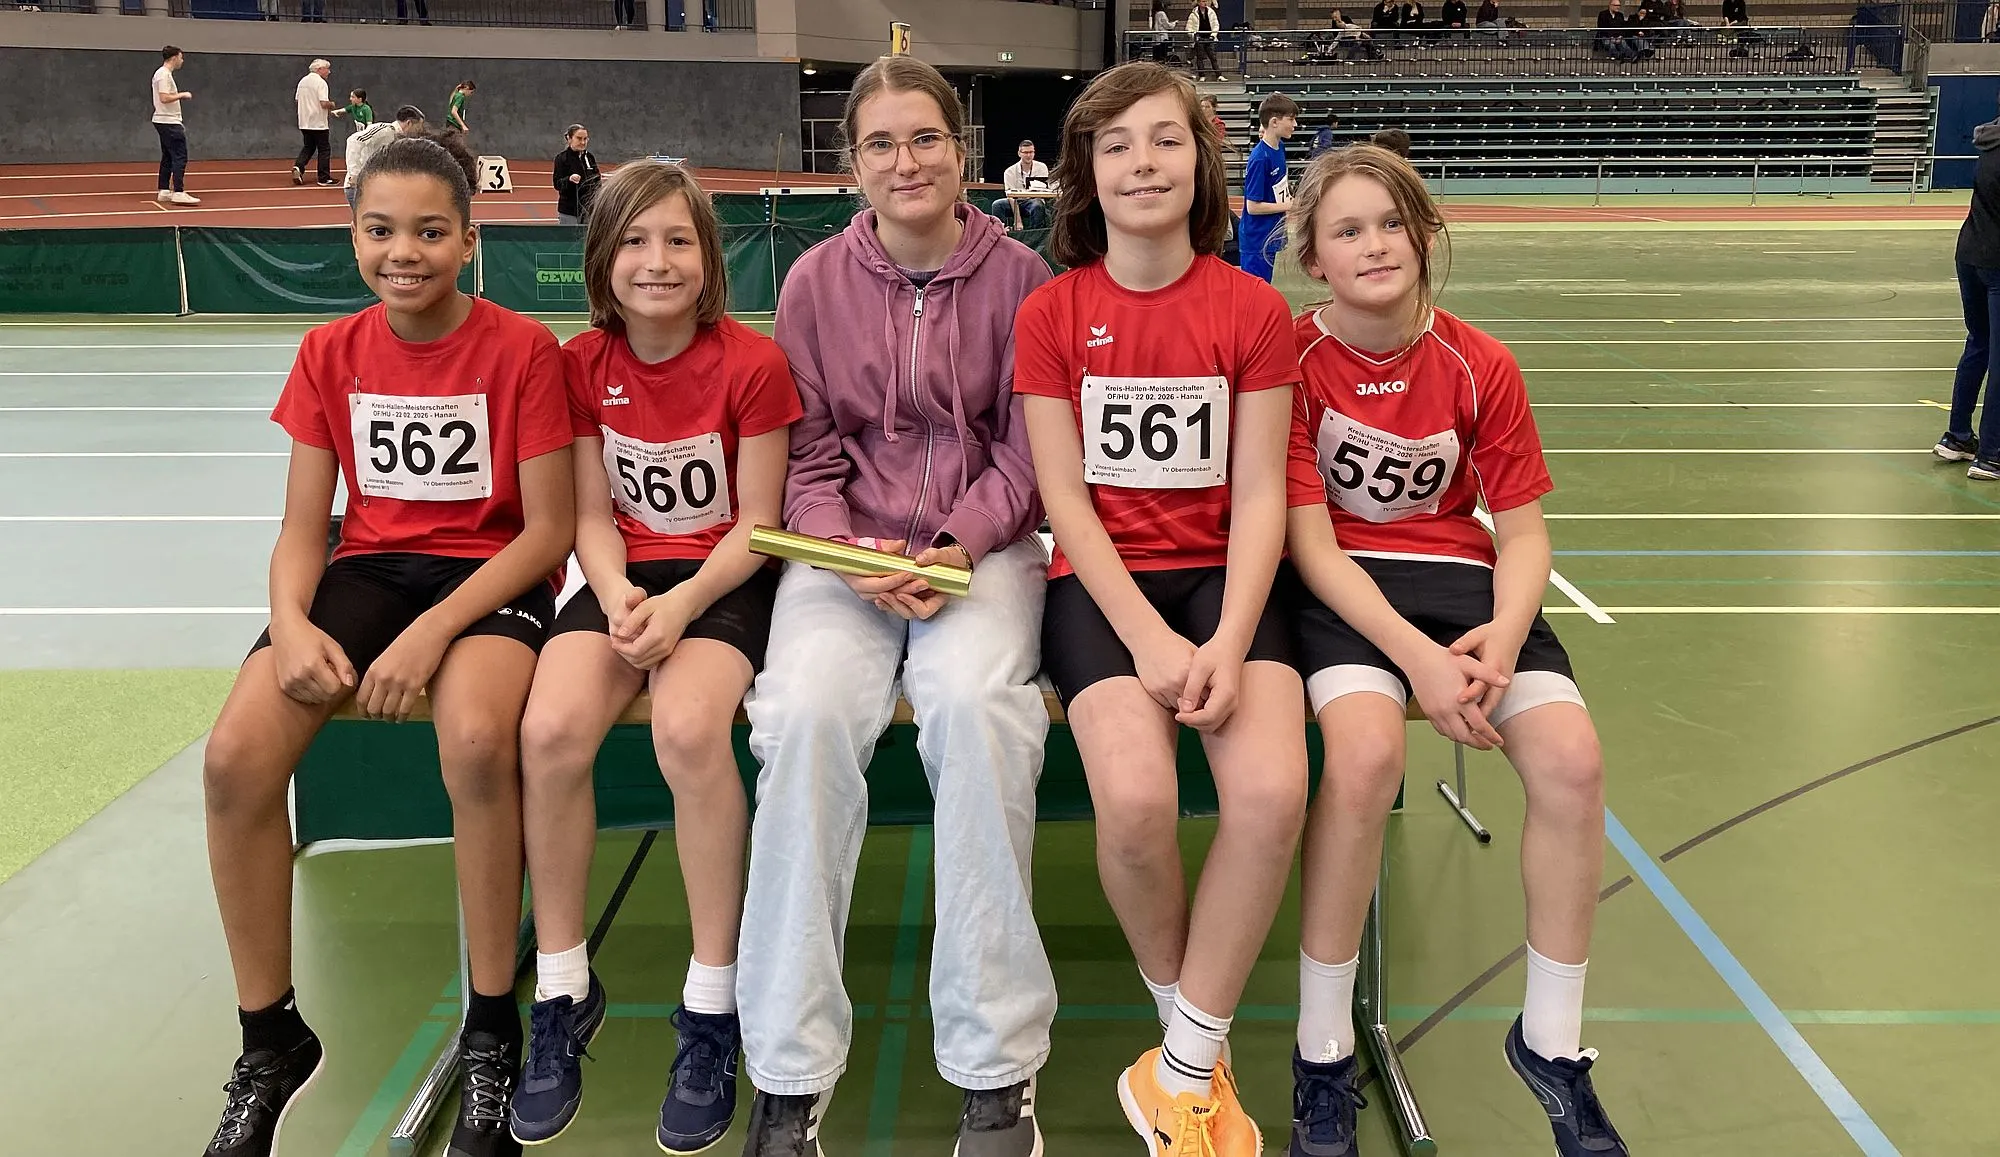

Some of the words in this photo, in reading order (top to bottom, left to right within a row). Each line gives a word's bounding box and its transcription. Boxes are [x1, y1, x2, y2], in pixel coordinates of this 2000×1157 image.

[488, 165, 505, 189] 3
[535, 270, 586, 284] GEWO
[1086, 335, 1114, 348] erima
[1355, 380, 1406, 396] JAKO
[602, 396, 630, 406] erima
[1101, 402, 1211, 461] 561
[370, 420, 479, 476] 562
[1347, 433, 1370, 446] OF/HU
[1396, 450, 1413, 458] 2026
[673, 452, 696, 461] Hanau
[1329, 440, 1447, 504] 559
[616, 454, 717, 513] 560
[516, 610, 542, 629] JAKO
